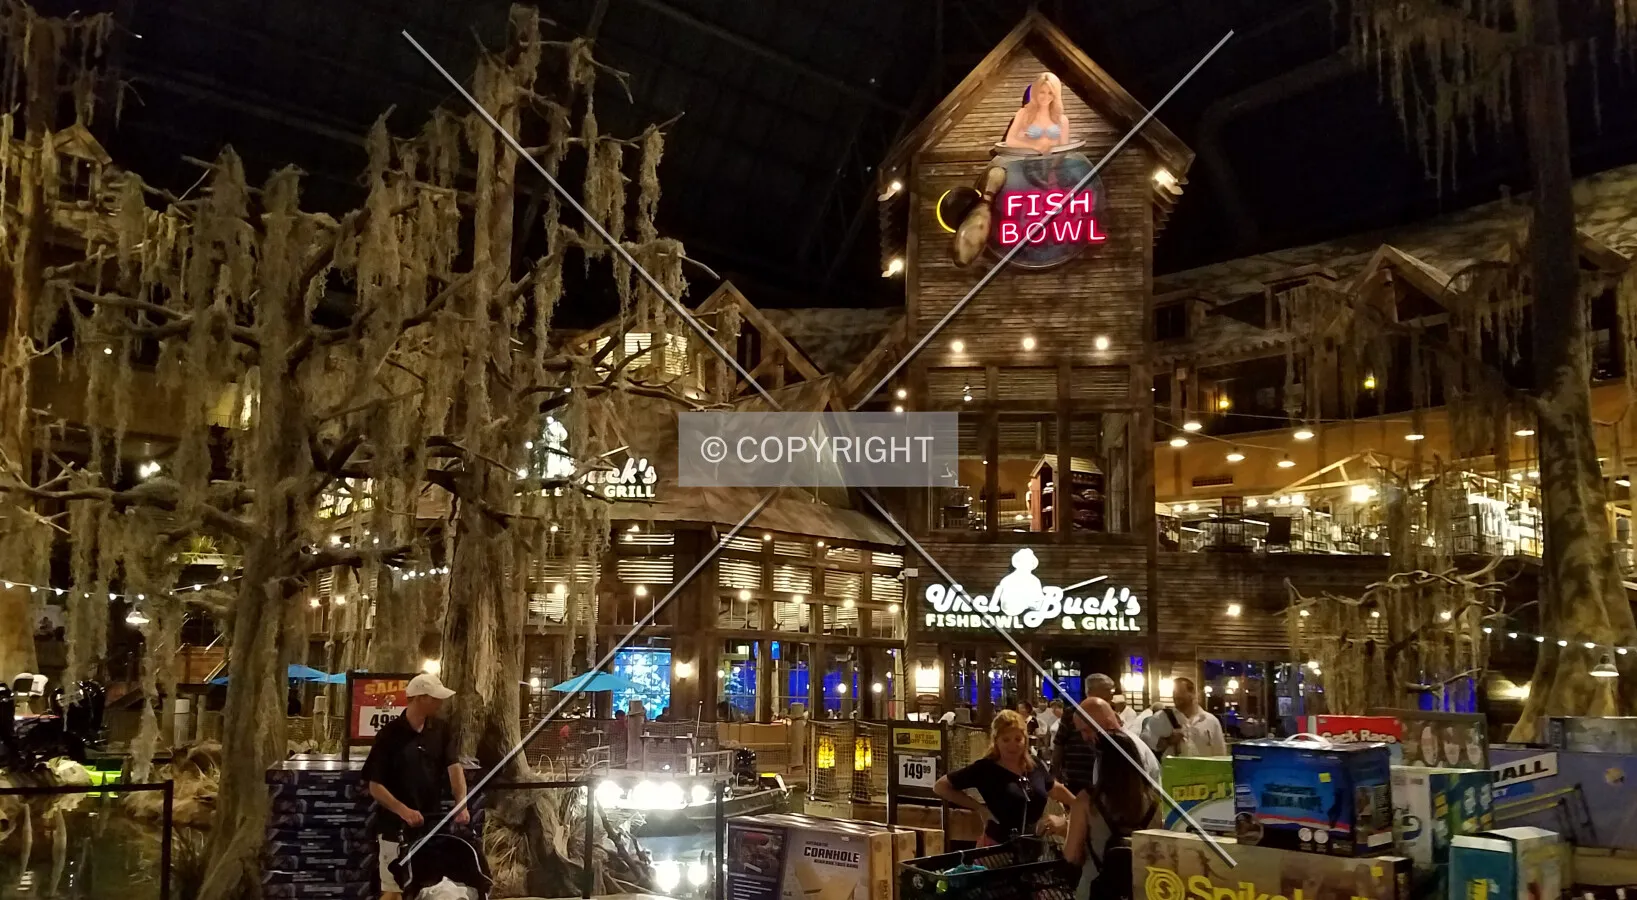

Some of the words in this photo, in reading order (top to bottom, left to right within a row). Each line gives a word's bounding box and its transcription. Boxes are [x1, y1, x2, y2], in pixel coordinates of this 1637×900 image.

[1007, 191, 1089, 217] FISH
[1001, 219, 1106, 244] BOWL
[604, 485, 656, 498] GRILL
[925, 584, 1004, 613] Uncl
[1023, 585, 1141, 629] Buck's
[925, 614, 1024, 629] FISHBOWL
[1062, 616, 1077, 630] &
[1081, 616, 1141, 631] GRILL
[363, 680, 408, 696] SALE
[1321, 729, 1359, 743] Sack
[1360, 729, 1397, 744] Race
[804, 847, 860, 862] CORNHOLE
